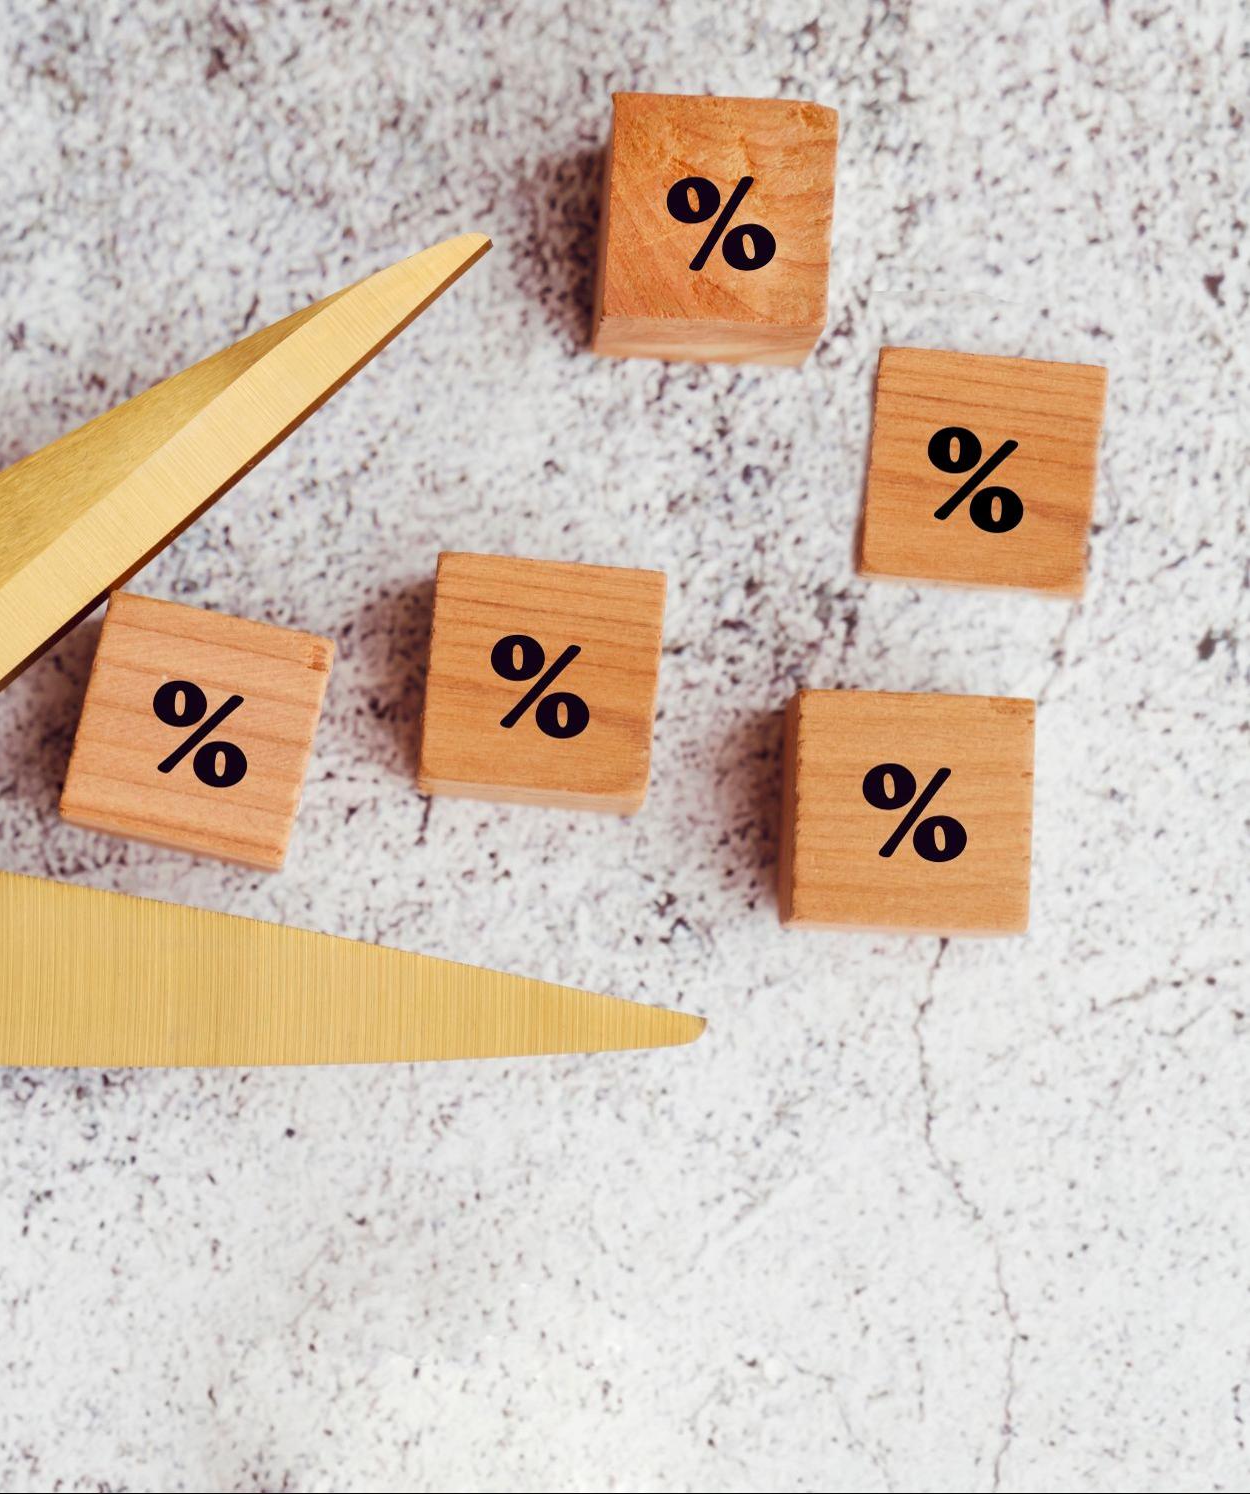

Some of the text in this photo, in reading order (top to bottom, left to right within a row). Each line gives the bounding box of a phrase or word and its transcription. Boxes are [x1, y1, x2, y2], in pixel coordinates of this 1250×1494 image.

[666, 176, 777, 272] %
[927, 426, 1024, 534] %
[152, 680, 248, 788] %
[490, 634, 590, 739] %
[862, 763, 968, 863] %
